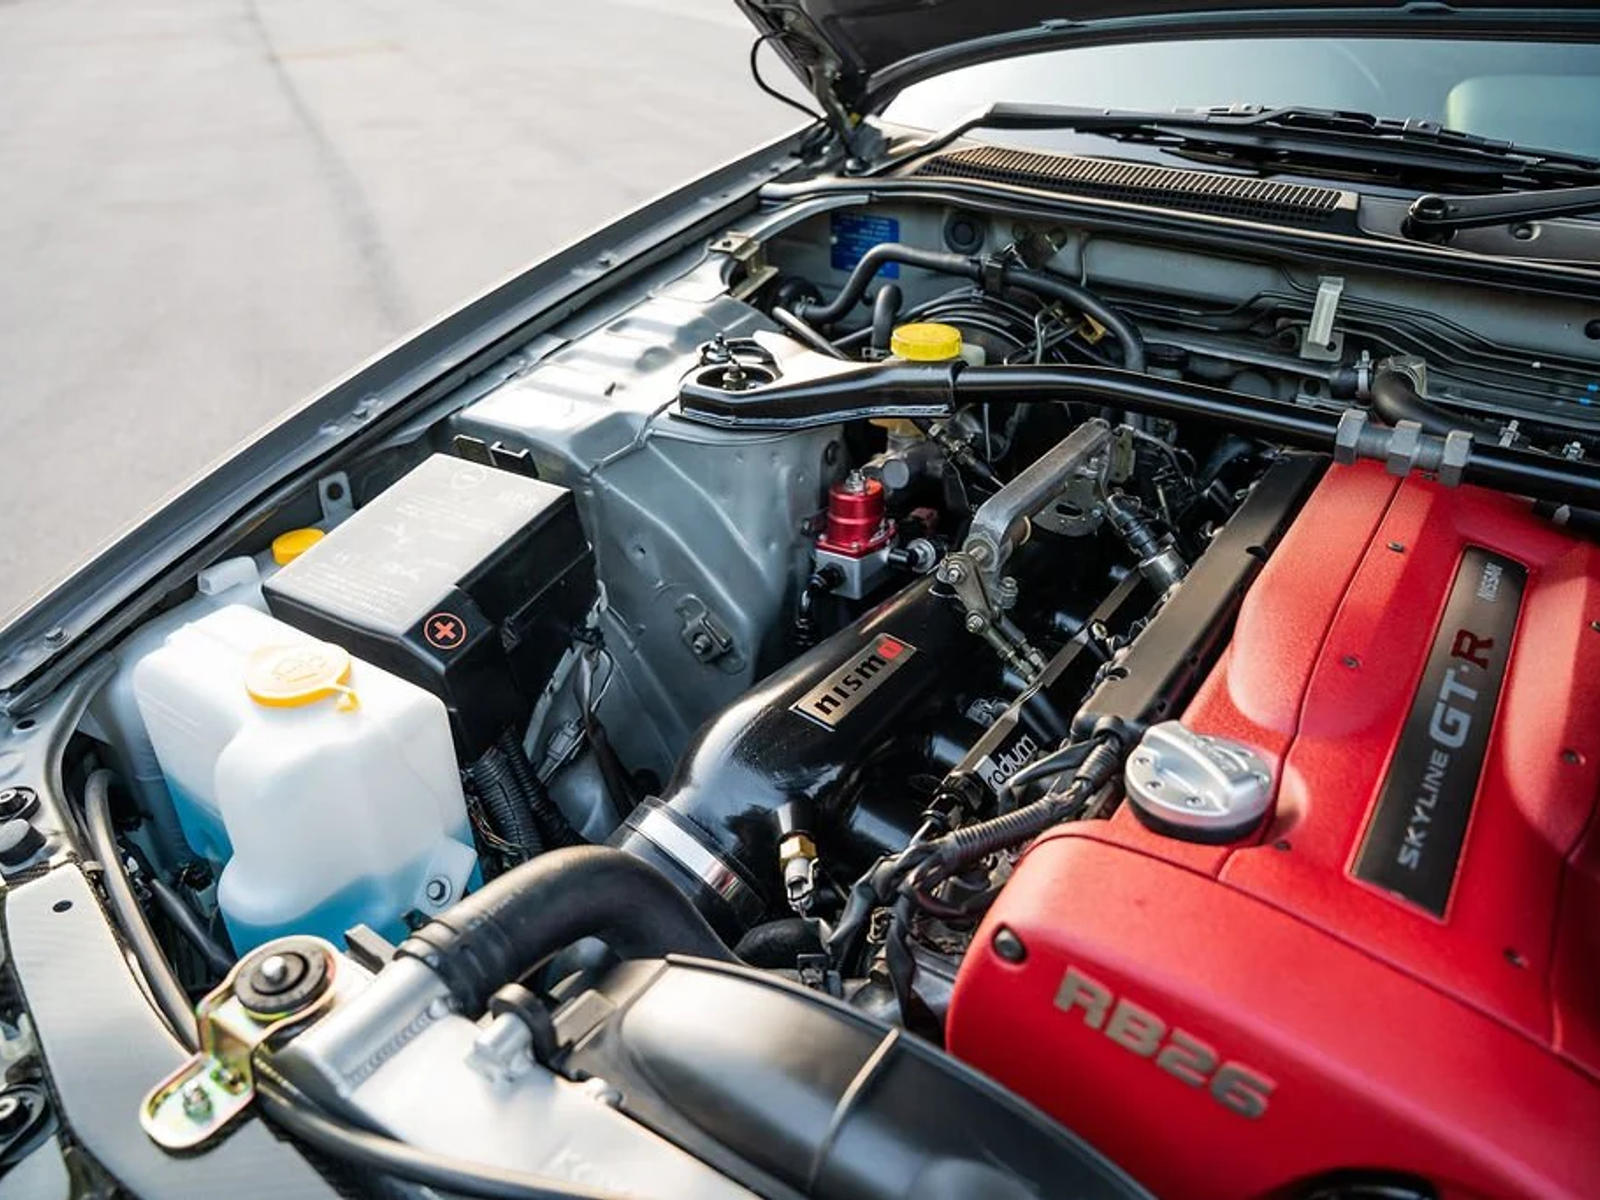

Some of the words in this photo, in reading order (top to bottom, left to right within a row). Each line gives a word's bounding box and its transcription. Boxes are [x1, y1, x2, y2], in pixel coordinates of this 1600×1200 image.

[1477, 562, 1504, 602] NISSAN
[814, 640, 903, 715] nismo
[1397, 750, 1449, 869] SKYLINE
[1053, 966, 1278, 1118] RB26
